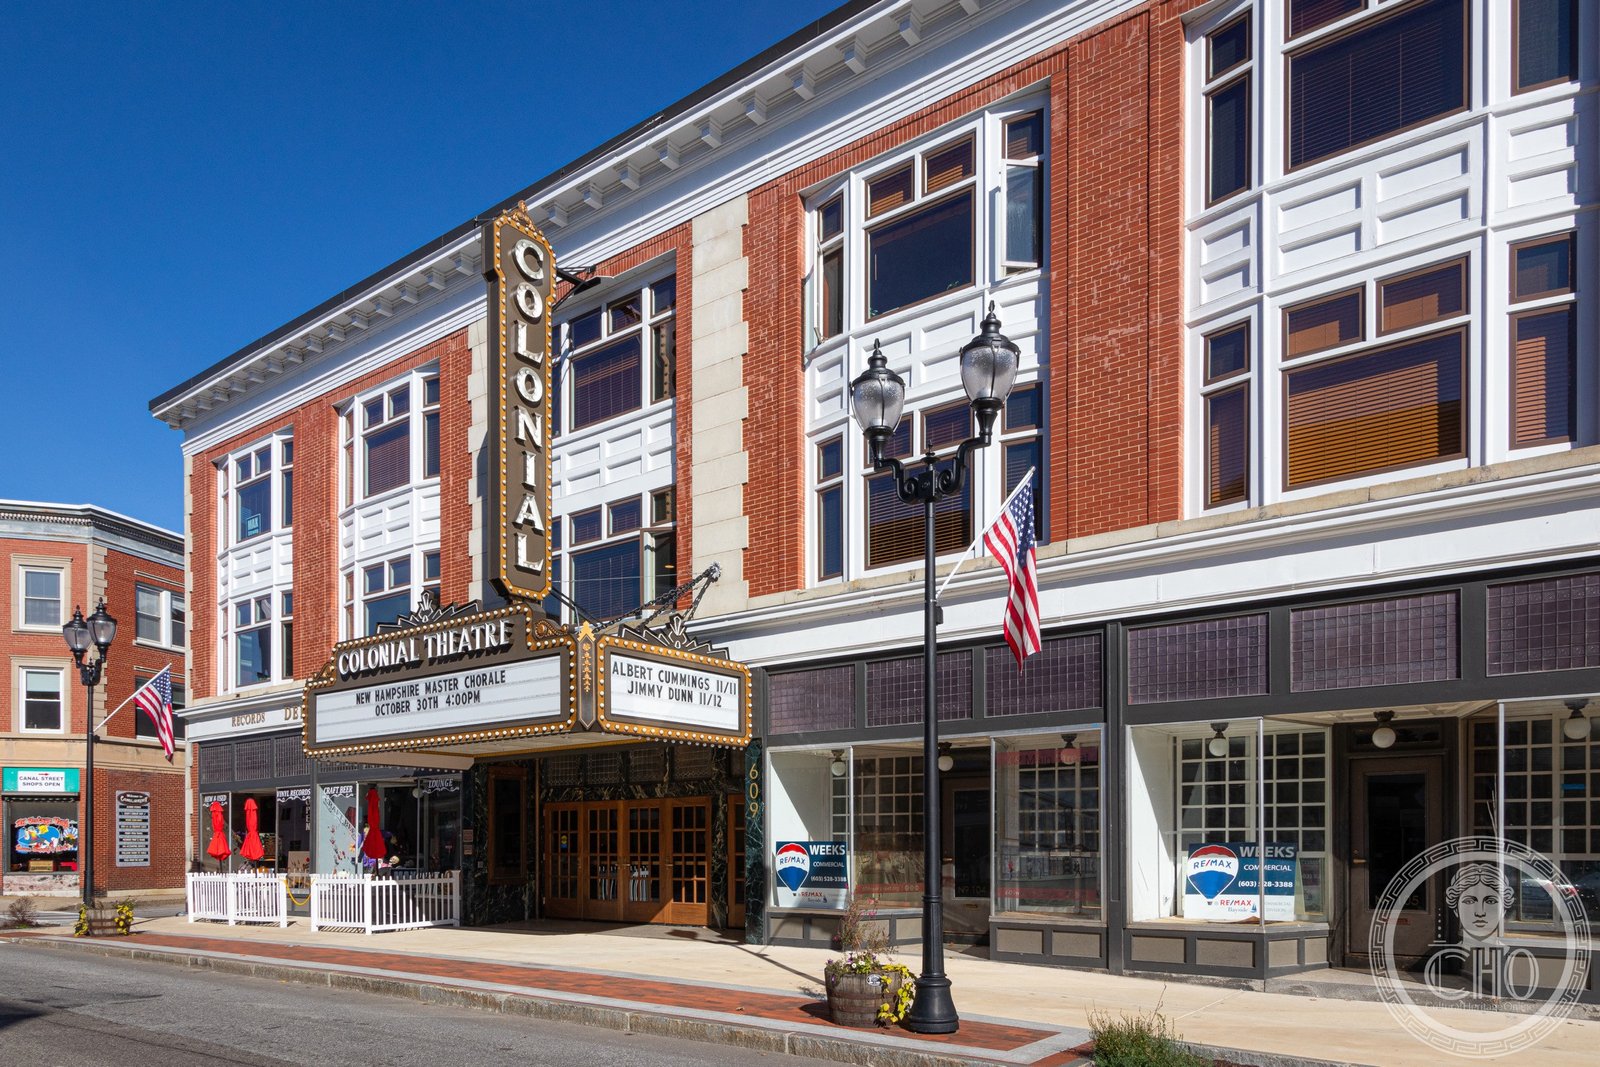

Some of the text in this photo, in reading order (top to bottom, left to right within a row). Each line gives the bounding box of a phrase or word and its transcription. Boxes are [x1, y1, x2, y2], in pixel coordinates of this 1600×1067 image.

[511, 238, 545, 574] COLONIAL
[338, 619, 512, 677] COLONIAL THEATRE
[612, 661, 737, 695] ALBERT CUMMINGS 11/11
[356, 670, 506, 705] NEW HAMPSHIRE MASTER CHORALE
[627, 680, 722, 708] JIMMY DUNN 11/12
[375, 690, 481, 717] OCTOBER 30TH 4:00PM
[231, 712, 266, 727] RECORDS
[323, 785, 353, 795] CRAFT BEER
[428, 778, 453, 788] LOUNGE
[290, 788, 311, 797] RECORDS
[749, 763, 759, 819] 609
[810, 845, 845, 855] WEEKS
[779, 856, 806, 866] RE/MAX
[1193, 859, 1232, 870] RE/MAX
[1238, 880, 1257, 888] (603)
